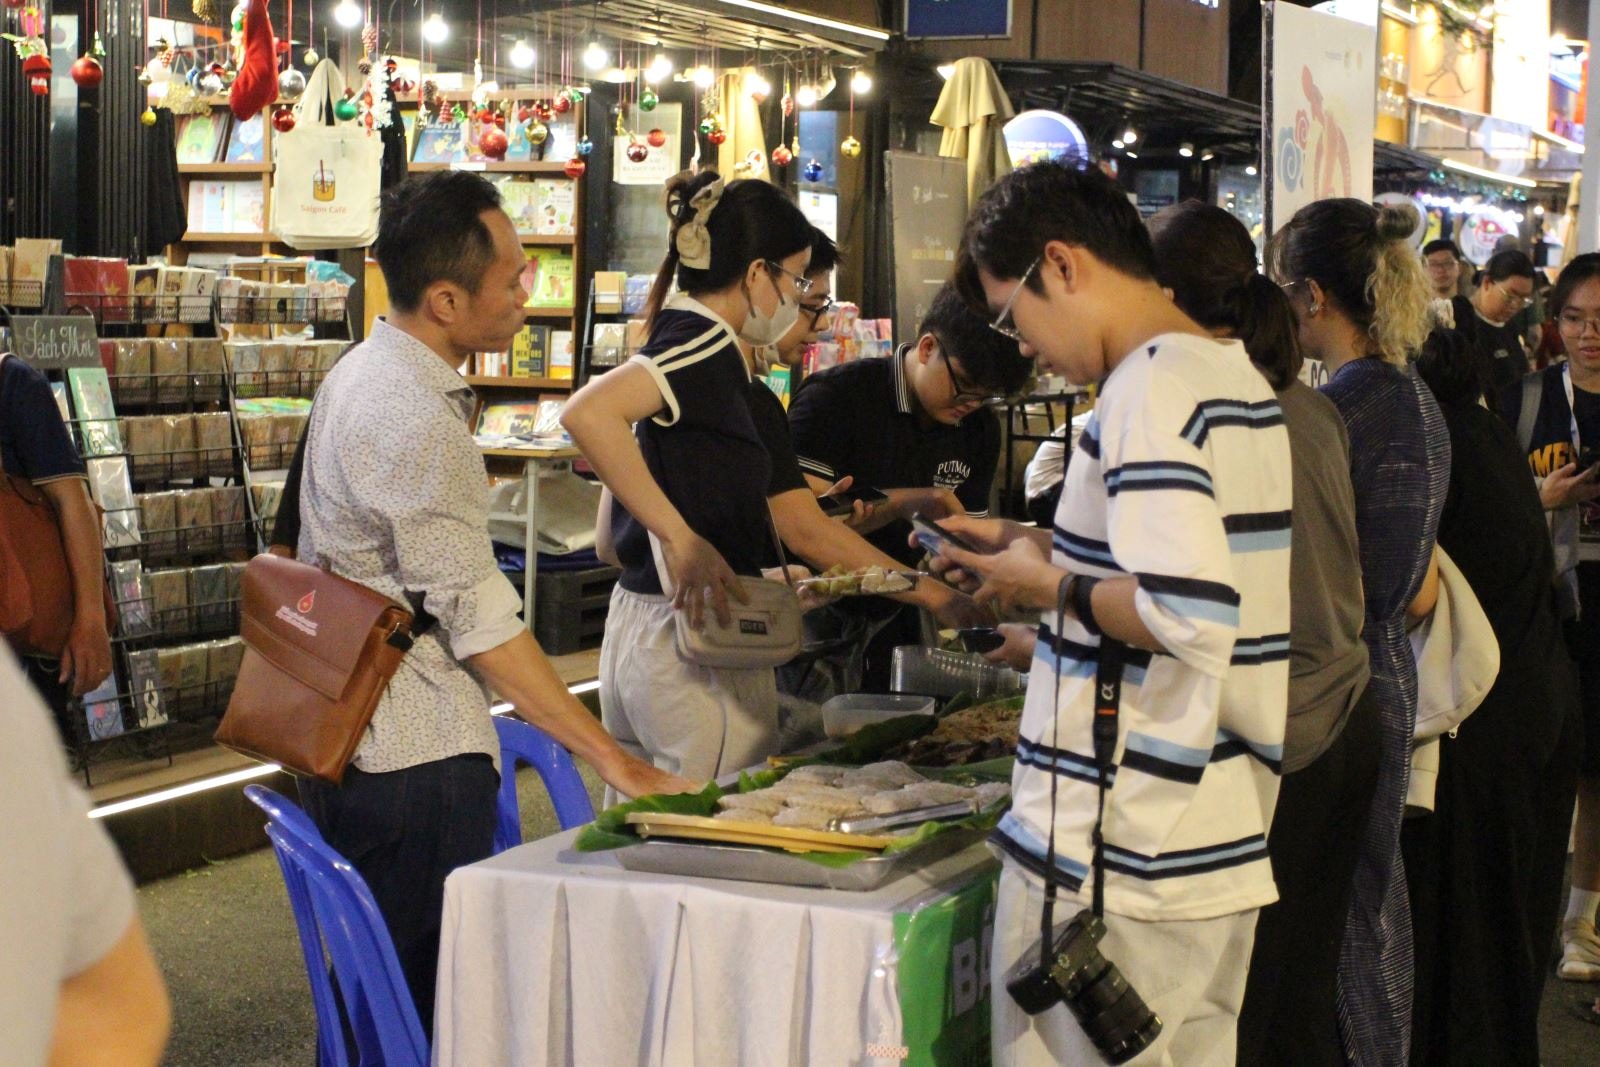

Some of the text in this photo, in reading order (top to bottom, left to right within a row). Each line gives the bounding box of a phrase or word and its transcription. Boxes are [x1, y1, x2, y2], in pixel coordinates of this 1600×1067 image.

[300, 204, 347, 215] Saigon Café
[22, 319, 60, 359] Sách
